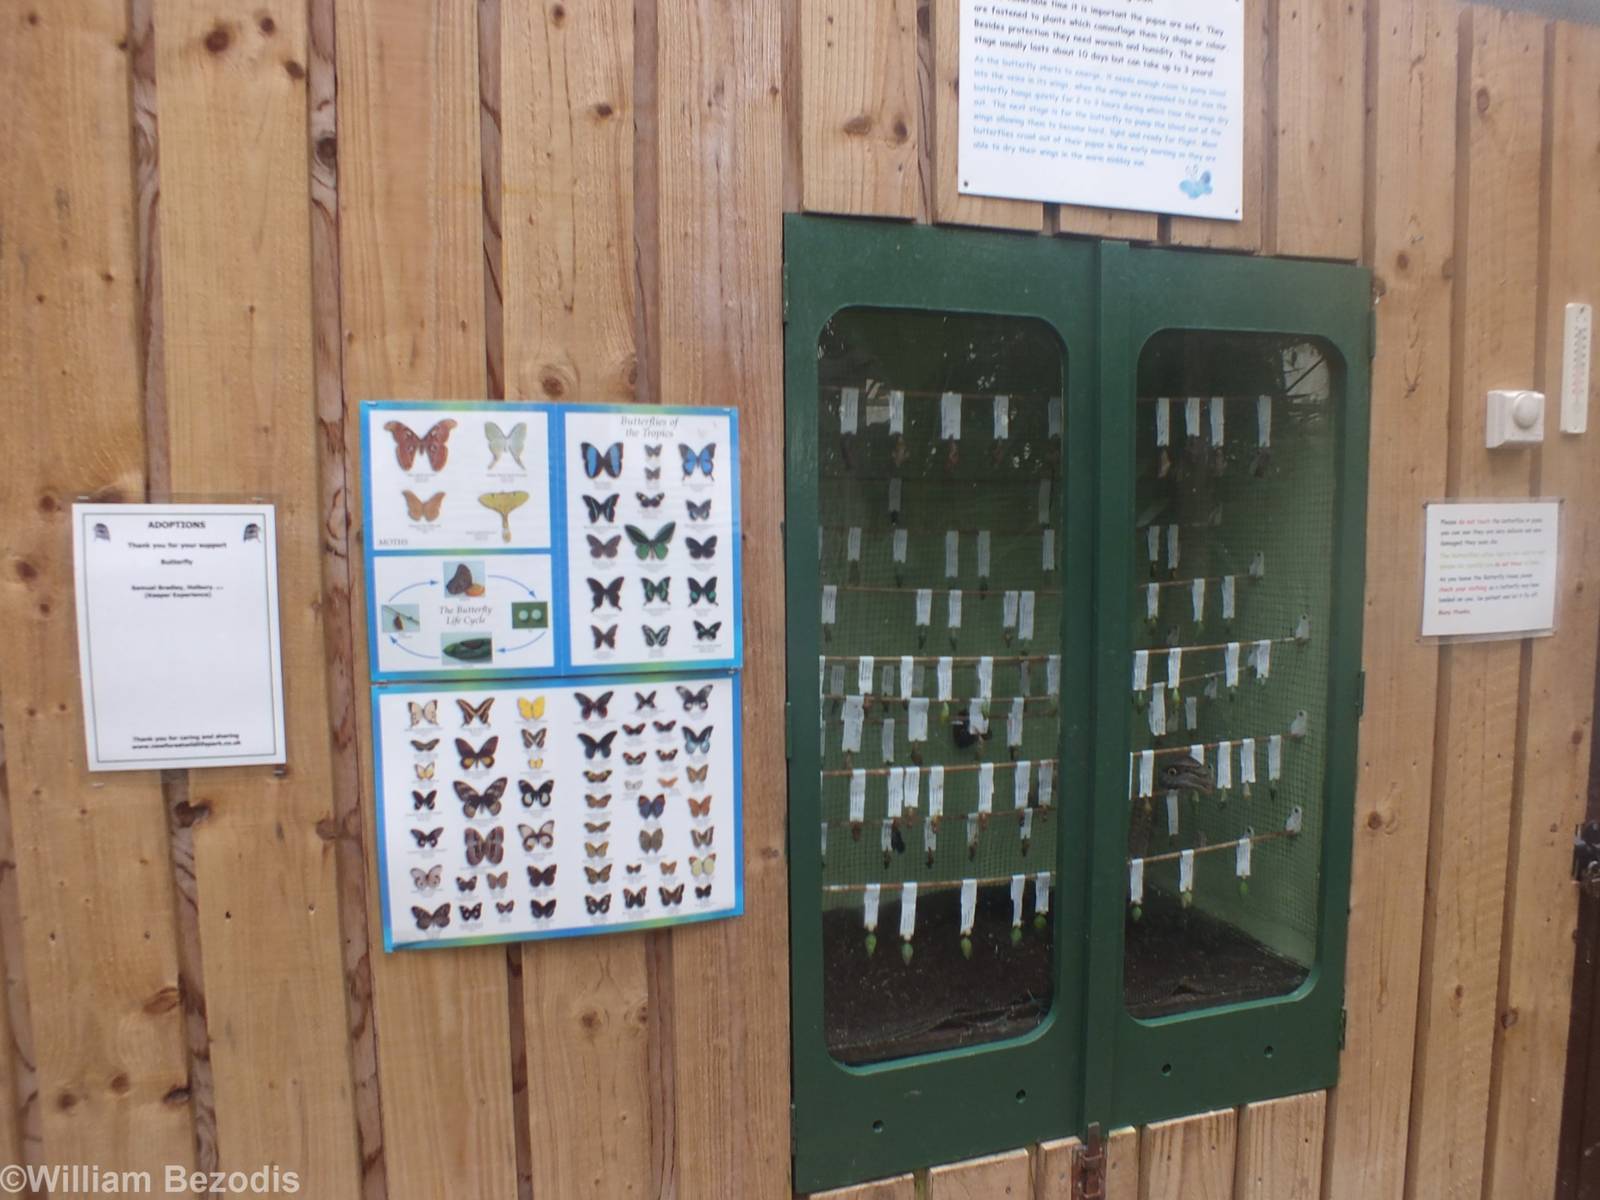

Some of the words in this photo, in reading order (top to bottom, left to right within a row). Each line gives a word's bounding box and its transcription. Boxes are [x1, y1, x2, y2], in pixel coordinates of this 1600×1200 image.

[974, 18, 1005, 30] Besides
[1008, 25, 1050, 37] protection
[1052, 30, 1070, 43] they
[620, 416, 667, 427] Butterflies
[670, 416, 679, 429] of
[626, 427, 640, 438] the
[643, 428, 675, 439] Tropics
[148, 520, 206, 529] ADOPTIONS
[128, 541, 150, 549] Thank
[168, 541, 178, 549] for
[199, 542, 227, 550] support
[161, 558, 193, 567] Butterfly
[439, 605, 453, 615] The
[457, 605, 493, 616] Butterfly
[446, 616, 461, 626] Life
[463, 616, 486, 627] Cycle
[202, 733, 214, 741] and
